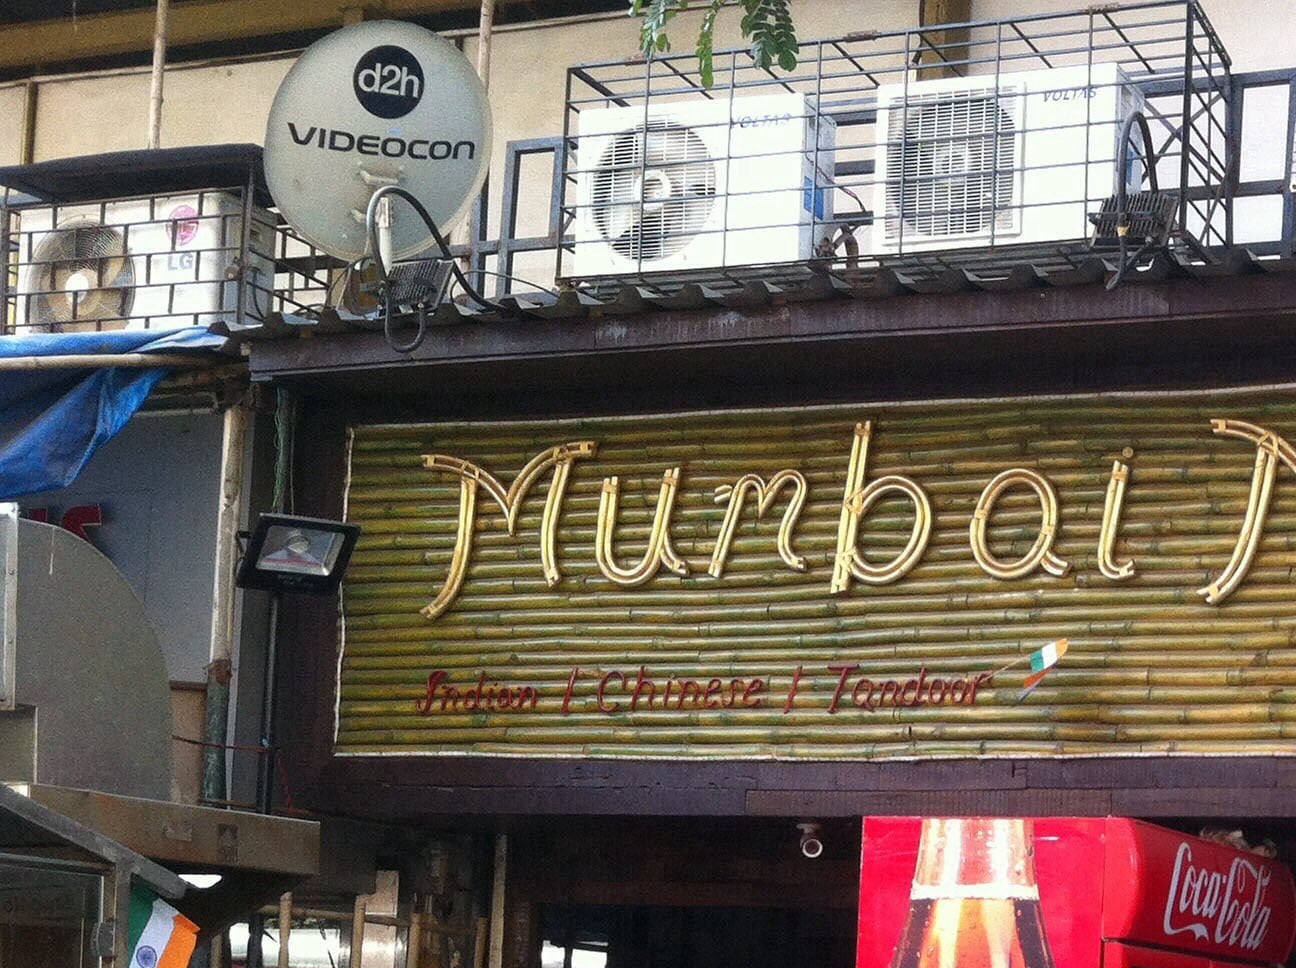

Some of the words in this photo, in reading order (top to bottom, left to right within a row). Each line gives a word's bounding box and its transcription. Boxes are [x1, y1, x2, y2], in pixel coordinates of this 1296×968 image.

[358, 63, 419, 98] d2h
[287, 122, 476, 160] VIDEOCON
[167, 251, 193, 271] LG
[420, 420, 1136, 620] Mumbai
[416, 669, 537, 715] Indian
[597, 665, 764, 713] Chinese
[827, 664, 994, 714] Tandoor
[1164, 842, 1272, 950] Coca-Cola
